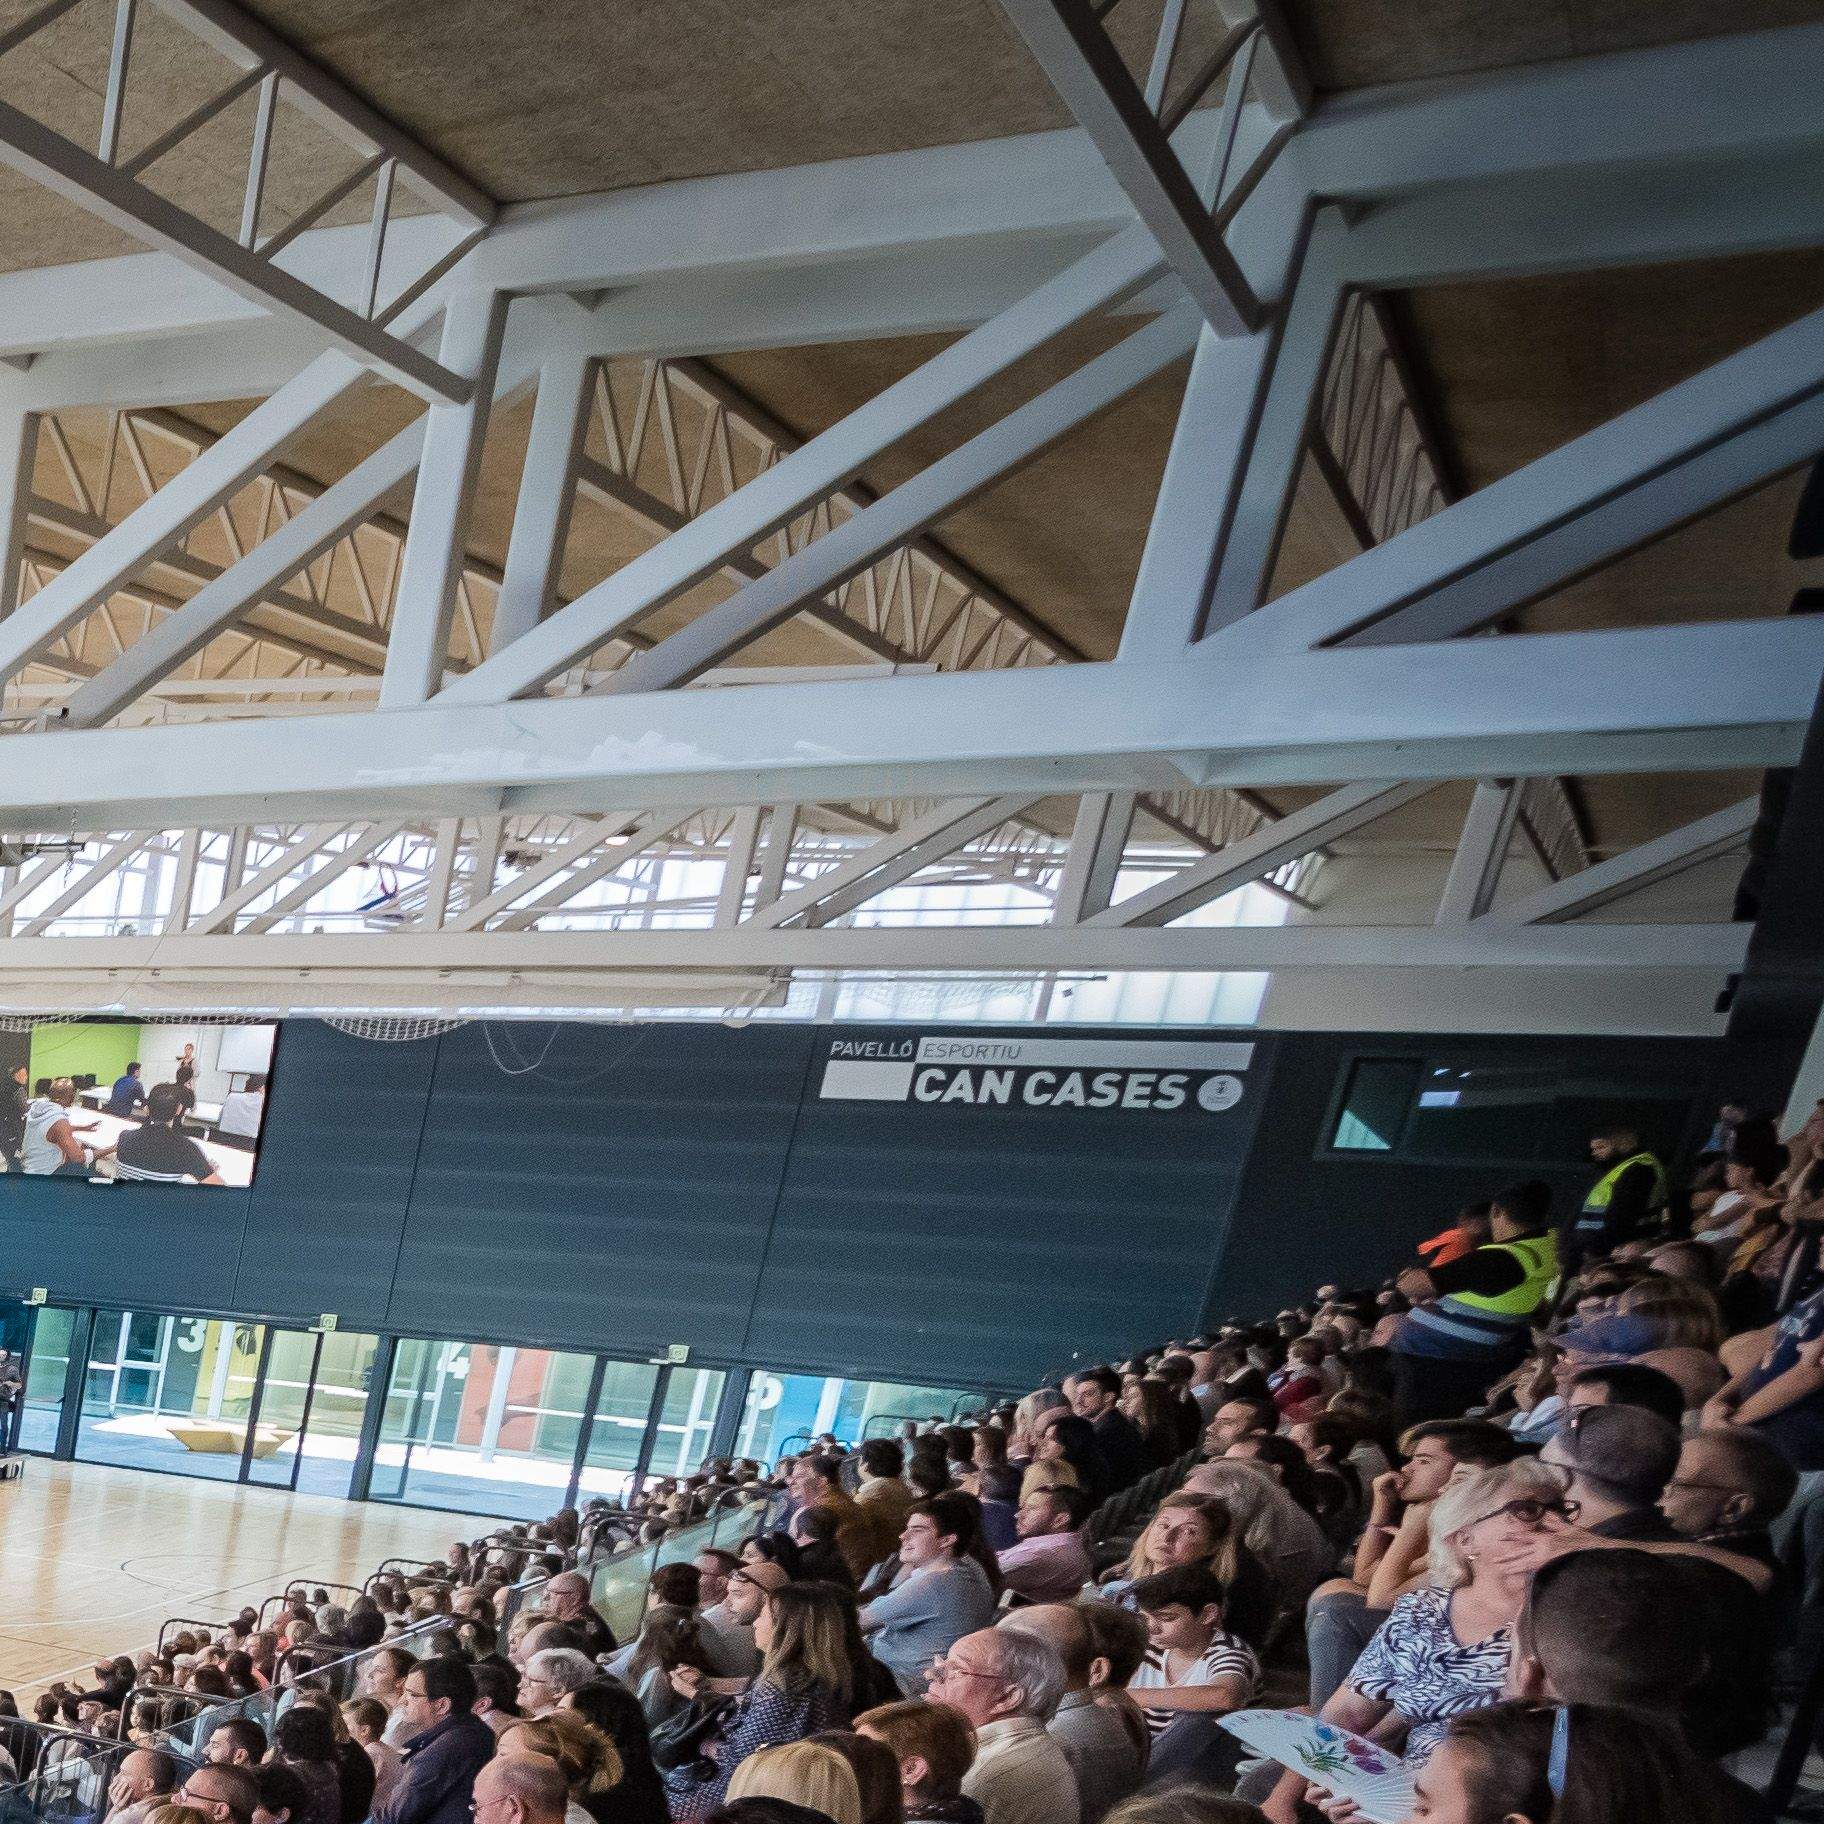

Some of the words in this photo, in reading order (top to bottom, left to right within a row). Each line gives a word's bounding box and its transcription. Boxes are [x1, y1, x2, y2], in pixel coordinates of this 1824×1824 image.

[830, 1040, 913, 1058] PAVELLÓ
[923, 1043, 1024, 1060] ESPORTIU
[914, 1068, 1015, 1104] CAN
[1022, 1070, 1190, 1110] CASES
[177, 1317, 208, 1353] 3
[436, 1341, 471, 1379] 4
